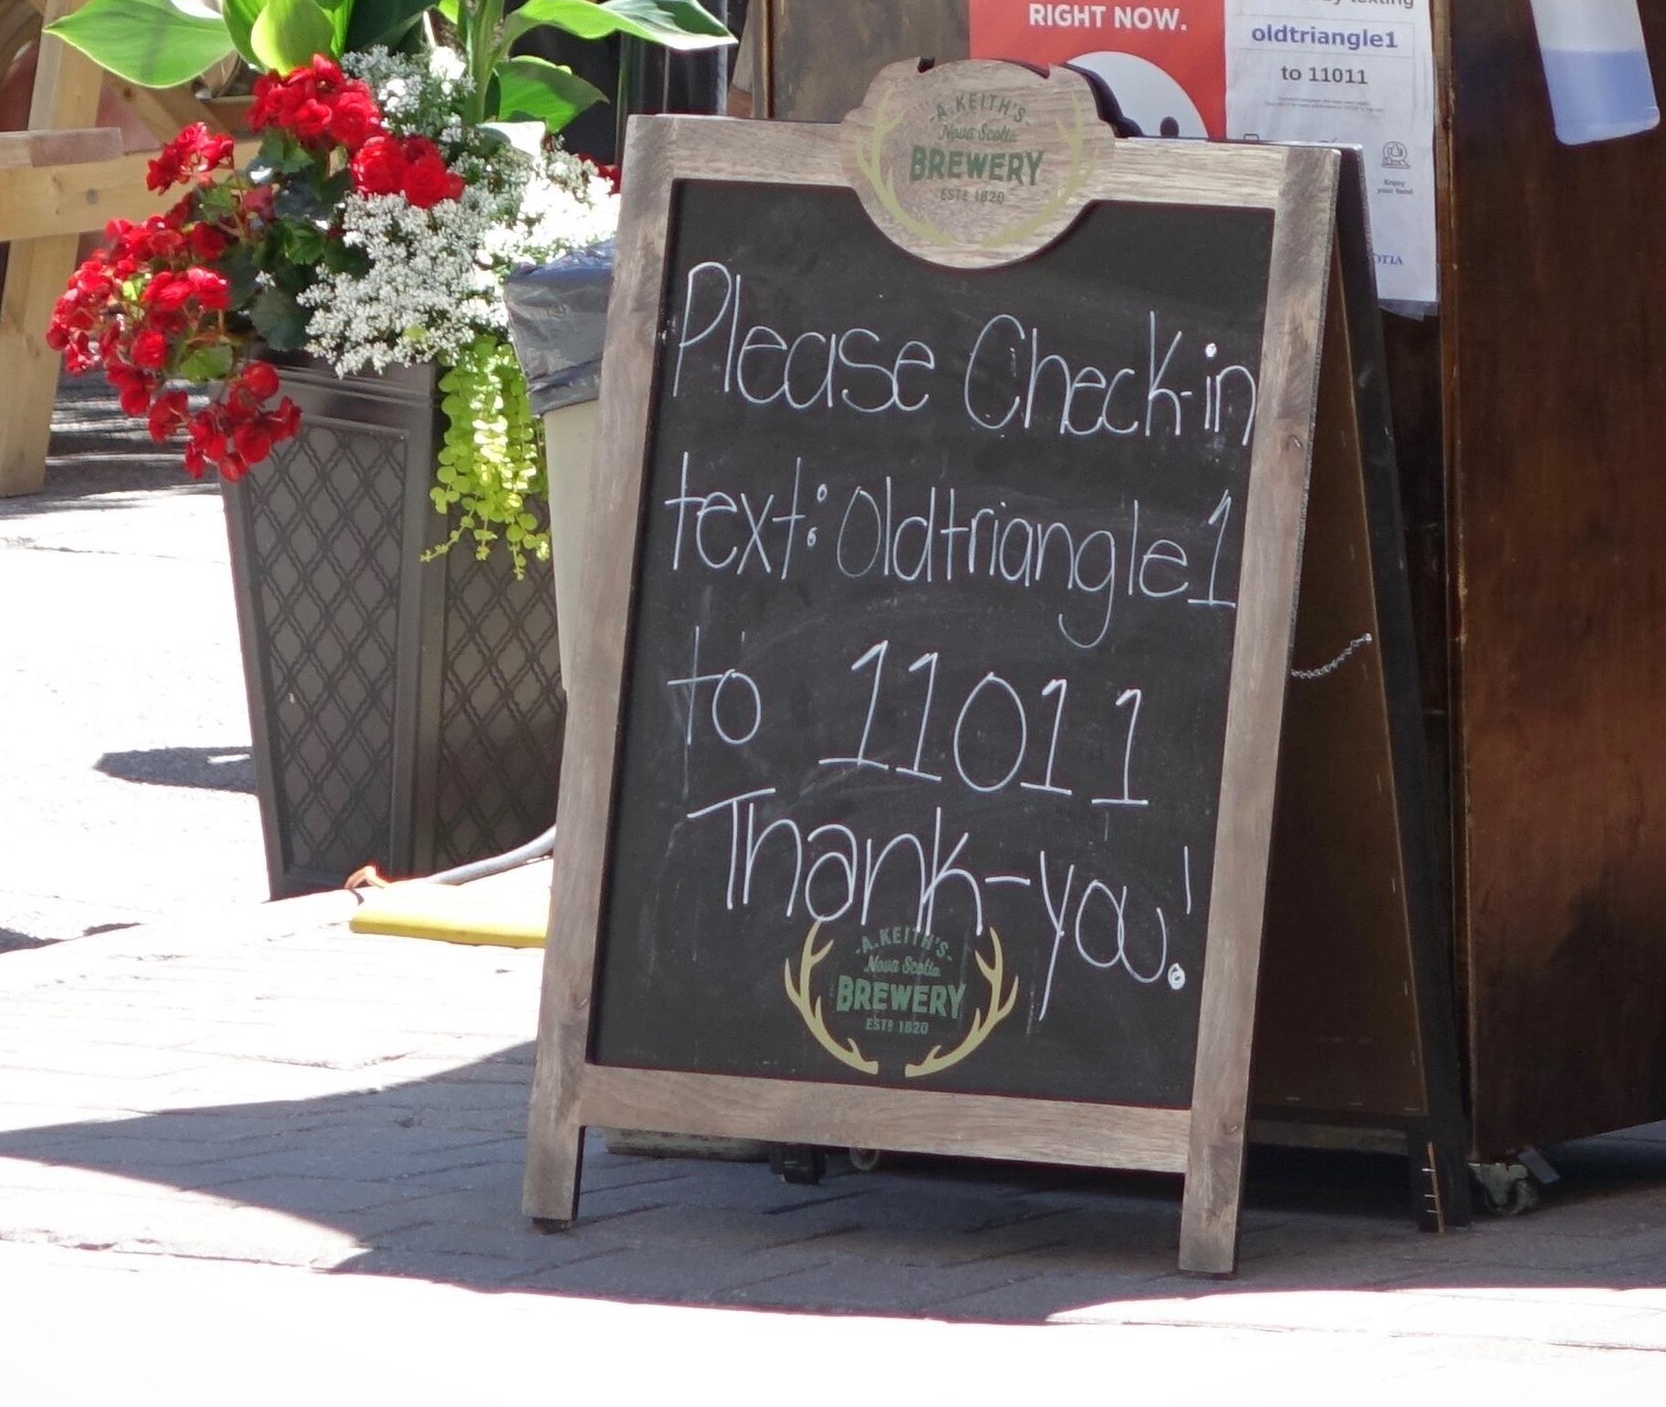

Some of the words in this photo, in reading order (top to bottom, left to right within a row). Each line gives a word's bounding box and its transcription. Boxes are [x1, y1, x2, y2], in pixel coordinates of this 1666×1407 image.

[1029, 3, 1106, 28] RIGHT
[1114, 6, 1187, 31] NOW.
[1251, 24, 1398, 51] oldtriangle1
[1281, 65, 1302, 81] to
[1308, 66, 1369, 84] 11011
[955, 92, 1028, 123] KEITH'S
[909, 145, 1045, 187] BREWERY
[985, 190, 1015, 204] 1820
[672, 260, 935, 413] Please
[964, 310, 1256, 446] Check-in
[667, 625, 762, 745] to
[818, 640, 1149, 805] 11011
[863, 954, 900, 973] Nova
[901, 955, 943, 977] Scotia
[836, 974, 967, 1020] BREWERY
[898, 1020, 930, 1035] 1820
